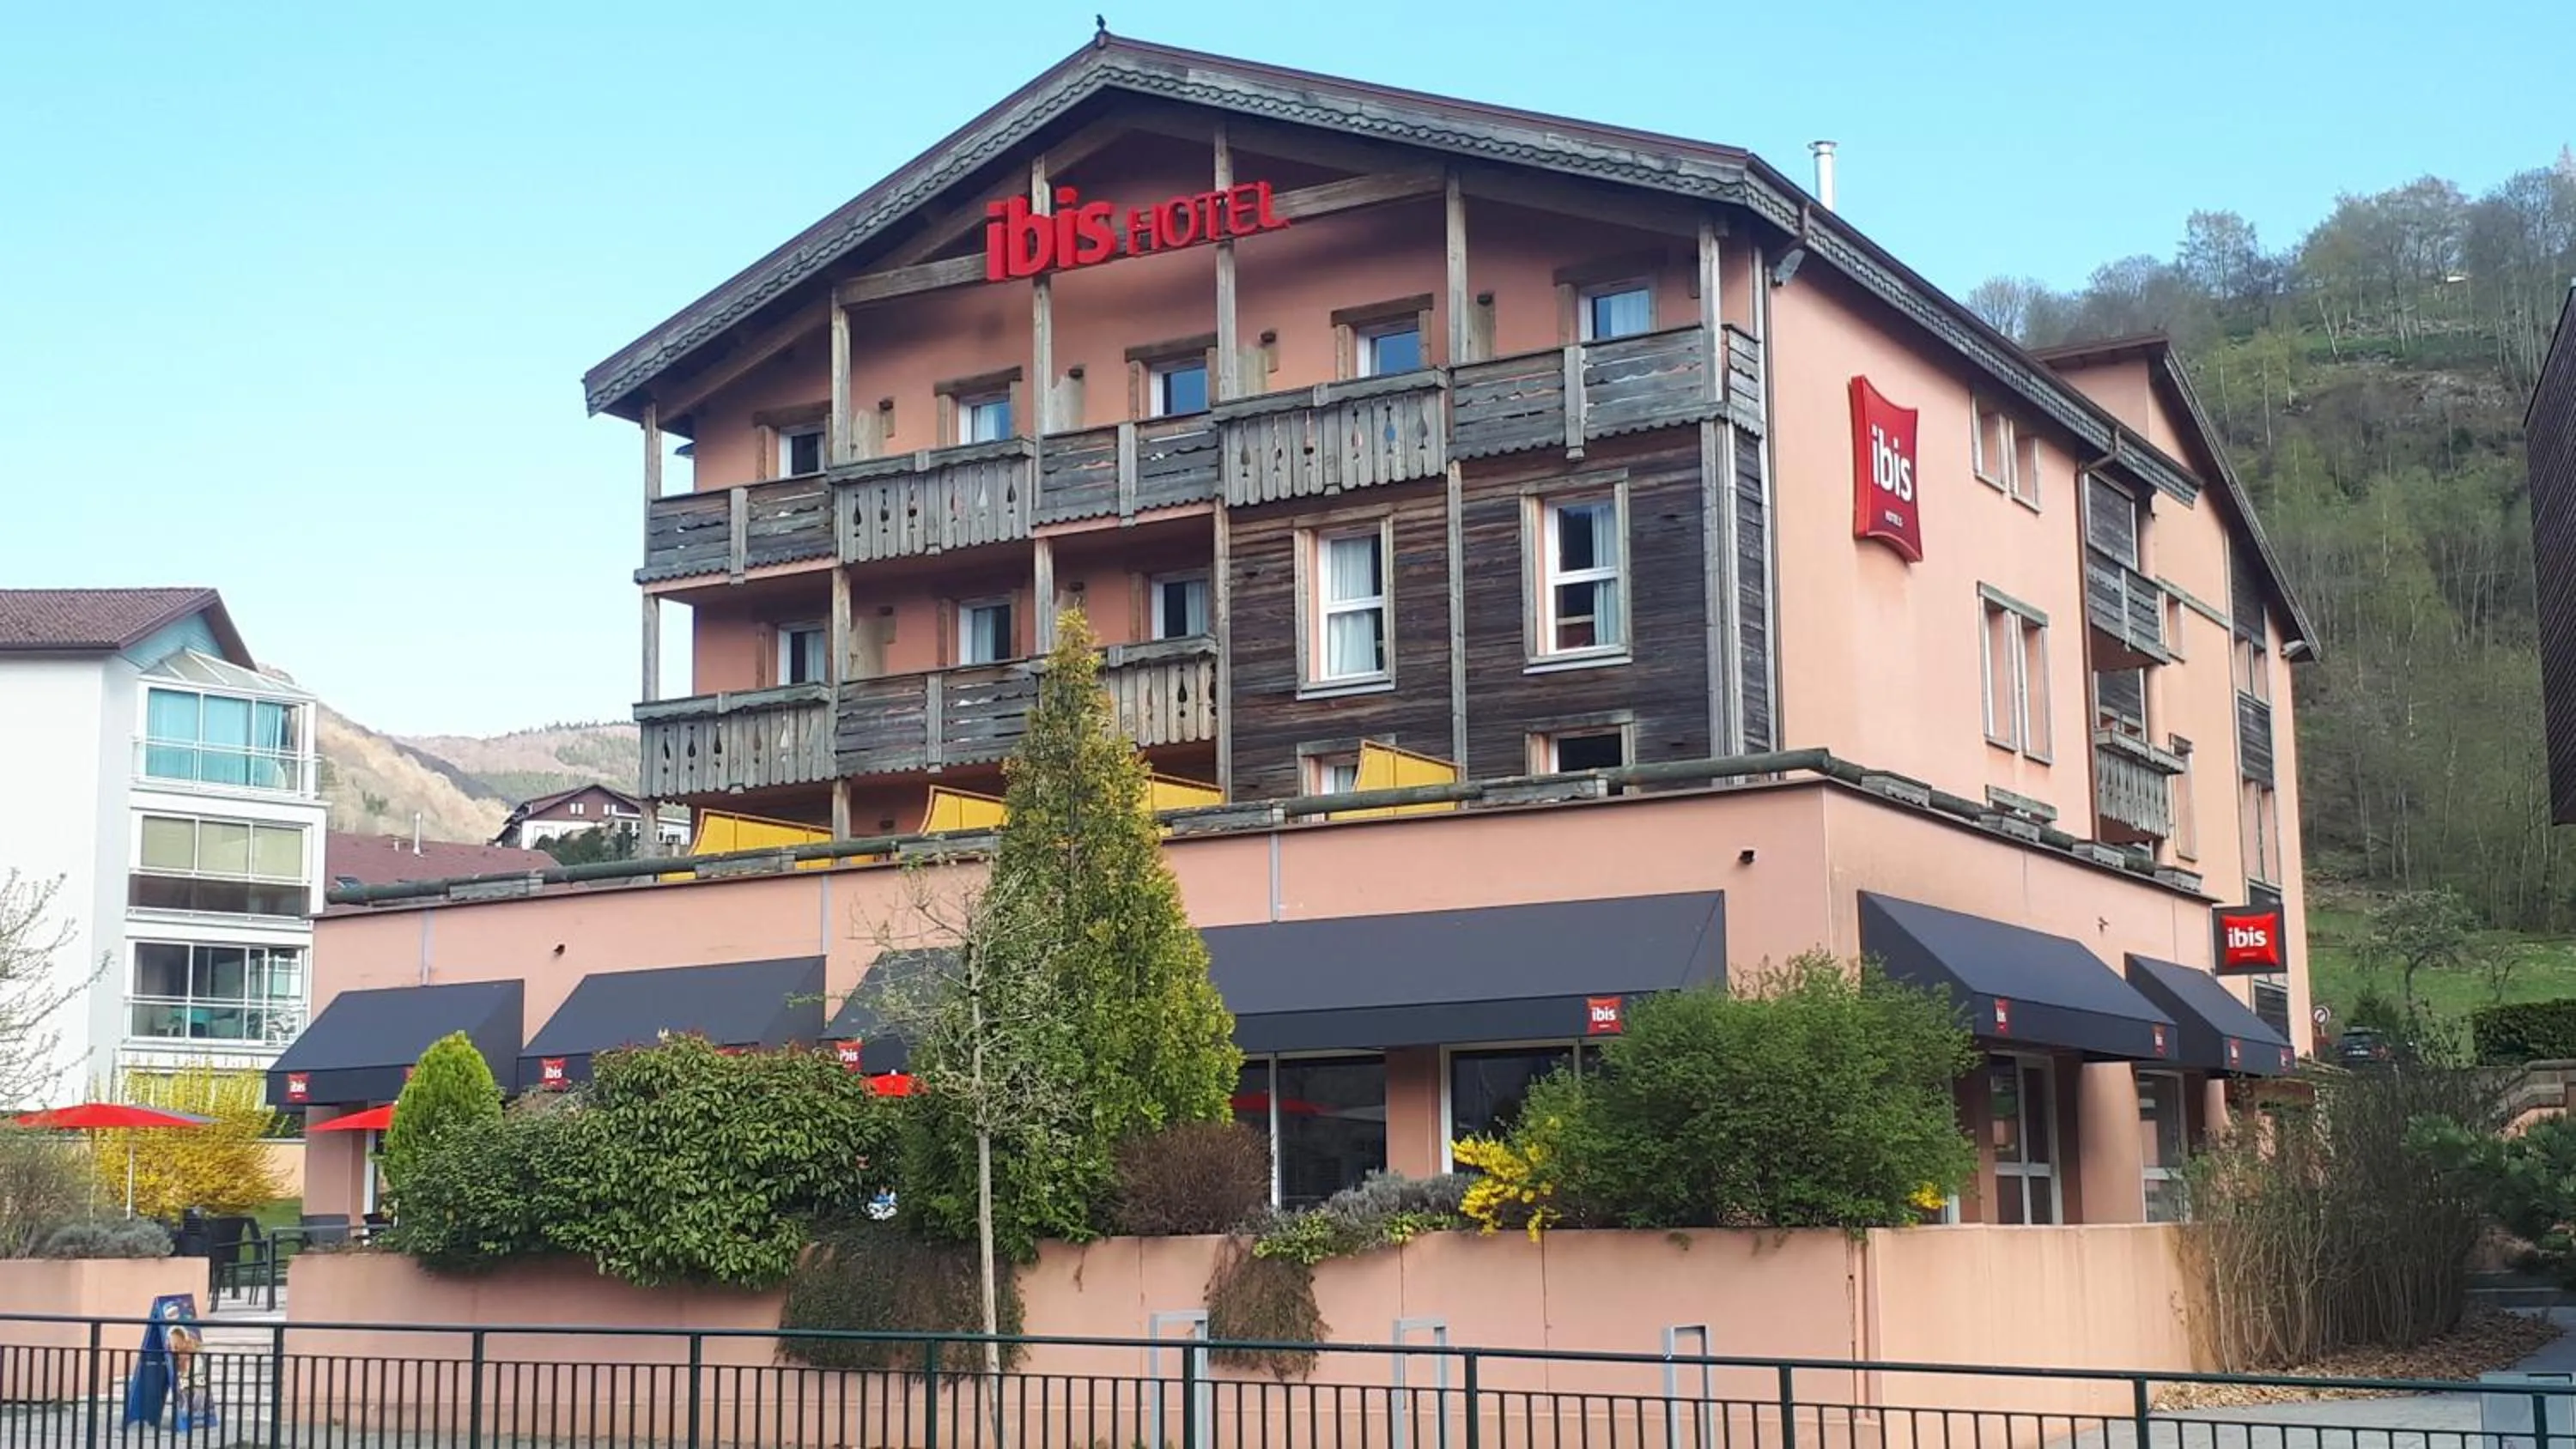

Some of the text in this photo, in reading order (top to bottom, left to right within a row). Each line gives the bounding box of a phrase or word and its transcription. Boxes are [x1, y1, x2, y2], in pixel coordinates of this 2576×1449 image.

[986, 180, 1289, 282] ibis HOTEL
[1871, 422, 1912, 502] ibis
[2227, 926, 2267, 948] ibis
[1591, 1005, 1616, 1022] ibis
